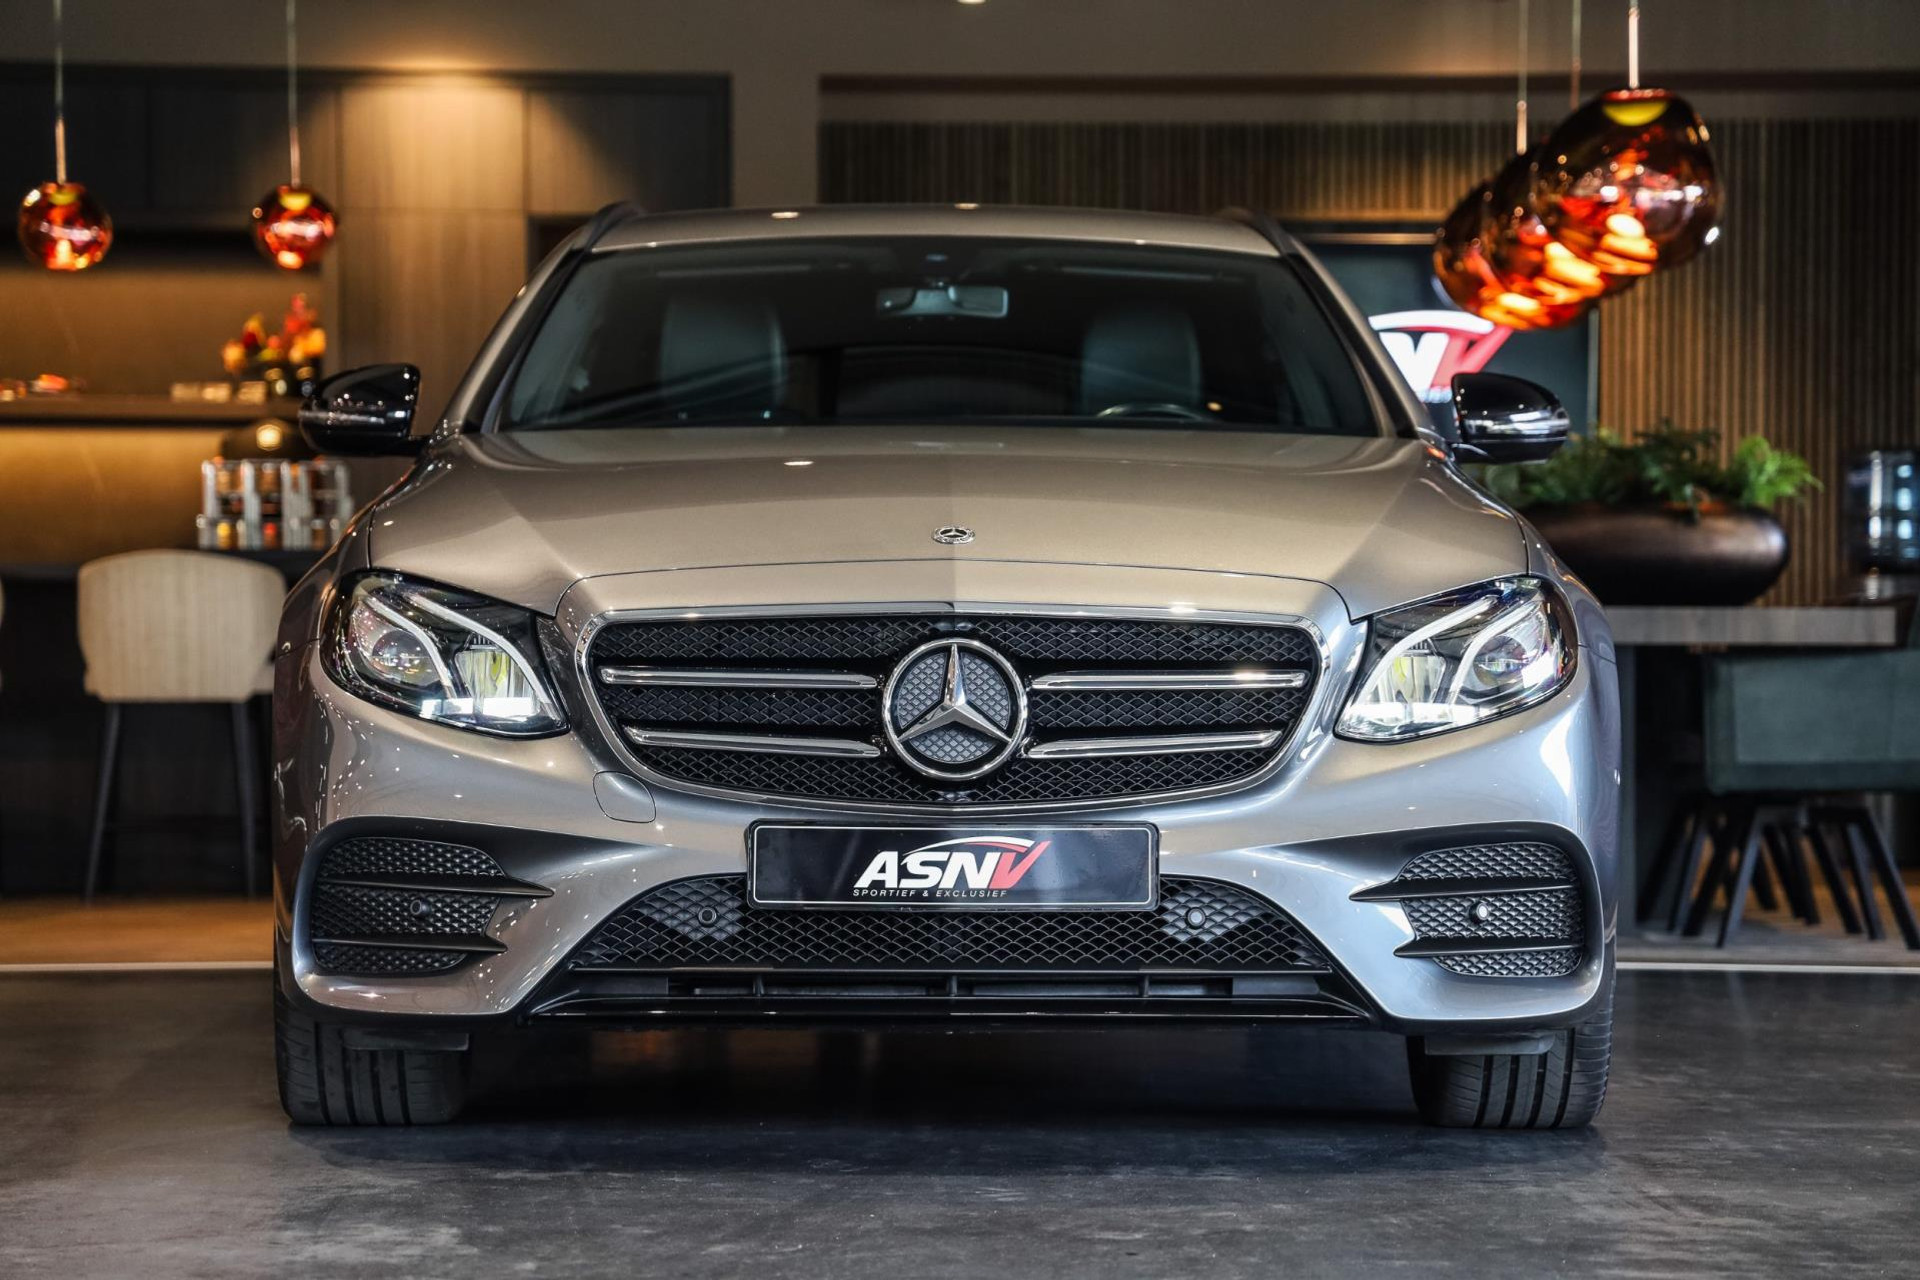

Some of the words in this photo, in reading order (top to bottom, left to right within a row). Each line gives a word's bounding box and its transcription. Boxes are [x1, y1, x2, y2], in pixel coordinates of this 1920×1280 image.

[853, 840, 1051, 889] ASNV
[852, 888, 916, 897] SPORTIEF
[922, 889, 929, 897] &
[935, 889, 1008, 898] EXCLUSIEF
